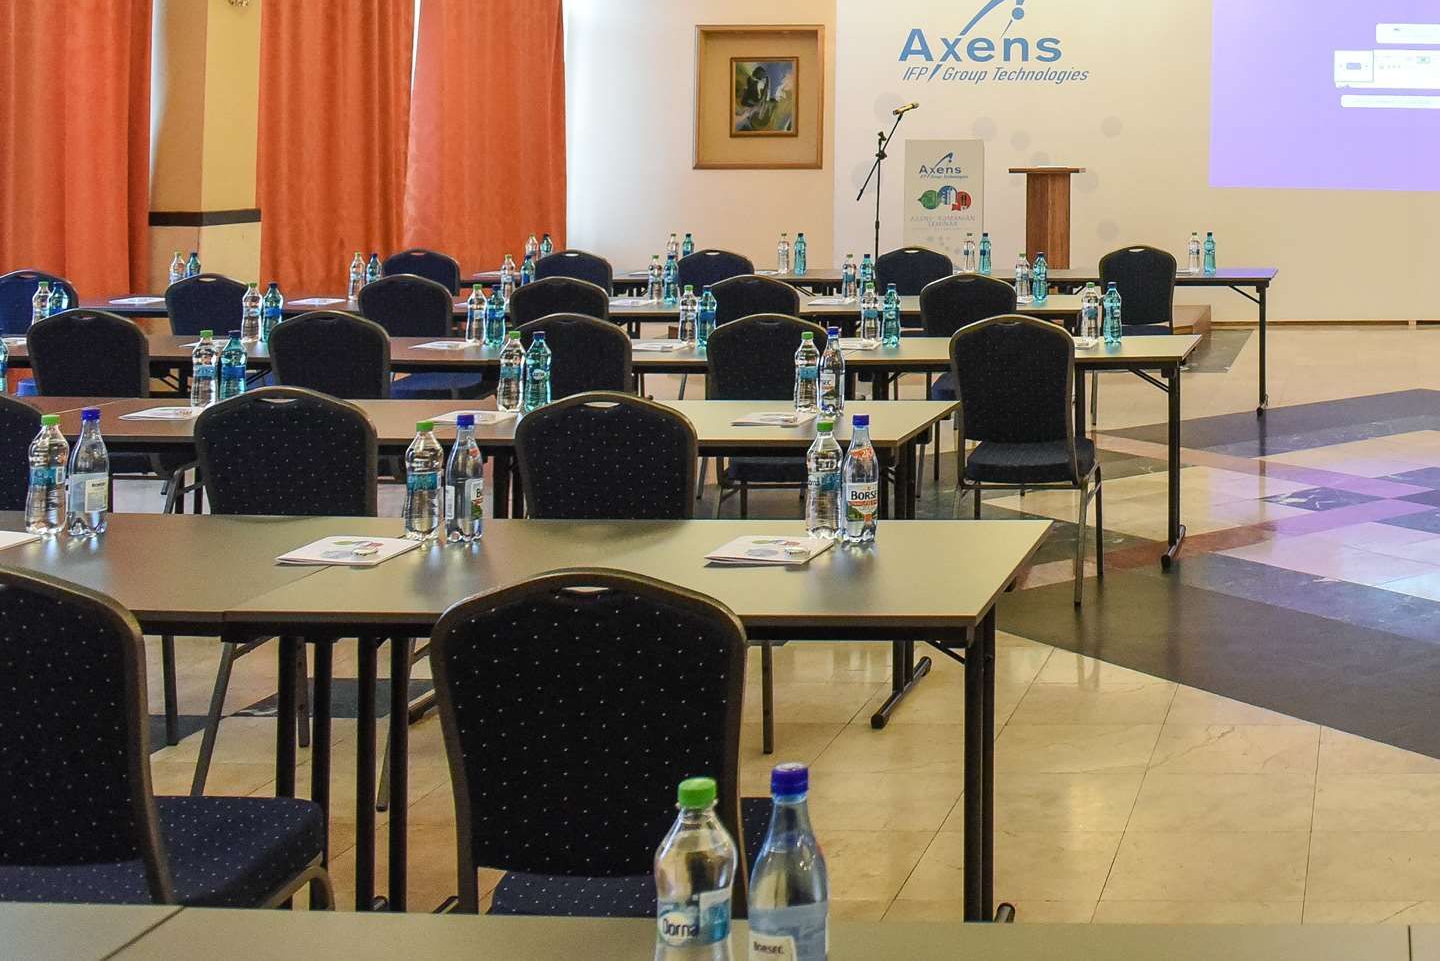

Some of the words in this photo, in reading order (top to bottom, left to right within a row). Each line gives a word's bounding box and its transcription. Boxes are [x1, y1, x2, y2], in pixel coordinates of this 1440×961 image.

[898, 28, 1063, 63] Axens
[942, 66, 988, 85] Group
[992, 66, 1090, 85] Technologies
[918, 164, 962, 175] Axens
